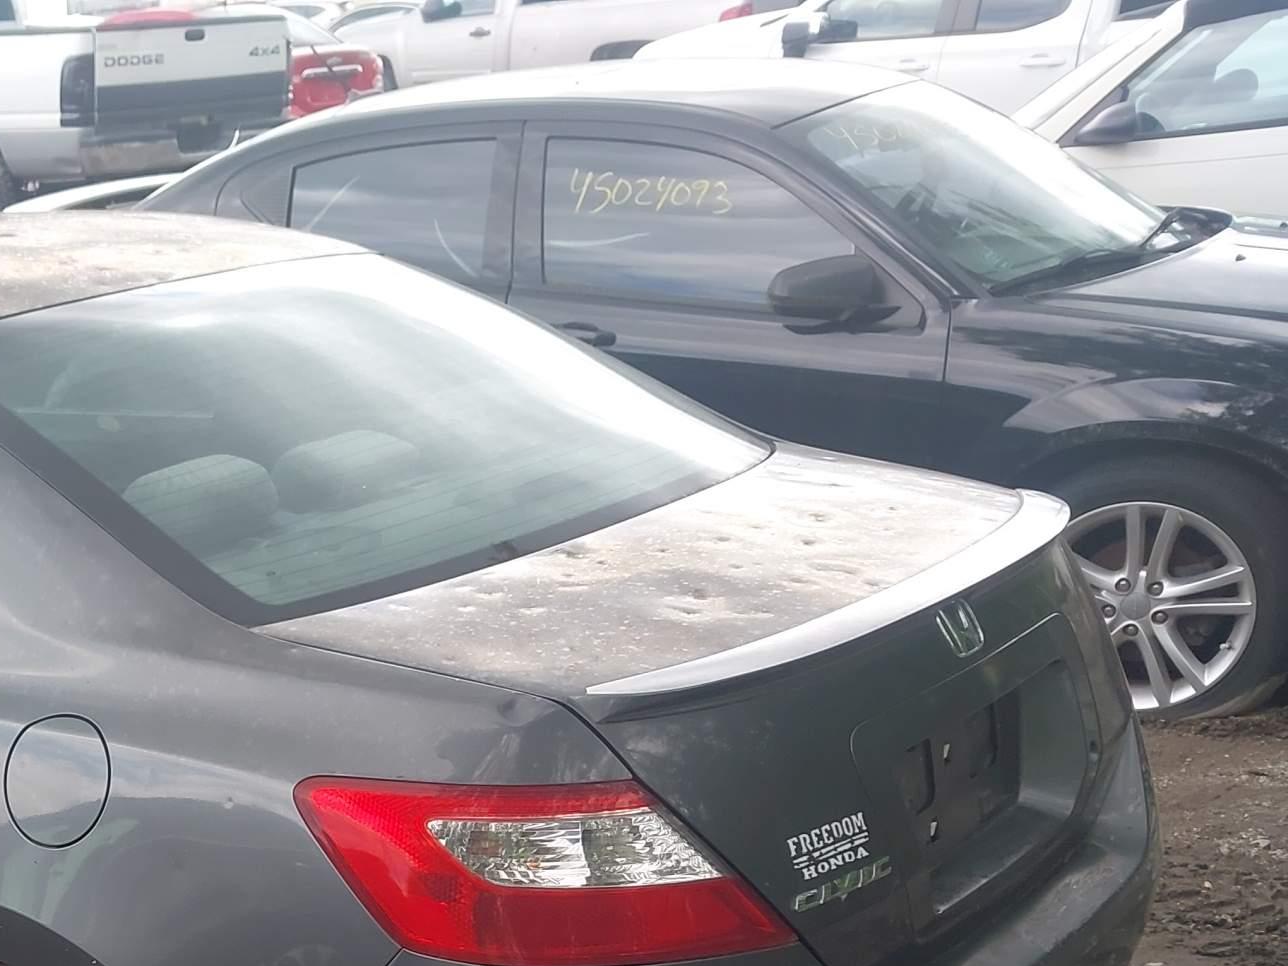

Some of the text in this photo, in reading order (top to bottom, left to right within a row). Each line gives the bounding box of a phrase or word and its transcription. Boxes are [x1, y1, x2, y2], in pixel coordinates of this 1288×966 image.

[103, 53, 165, 68] DODGE
[570, 168, 734, 214] 45024093
[787, 812, 867, 857] FREEDOM
[794, 856, 891, 912] CIVIC
[802, 846, 870, 880] HONDA
